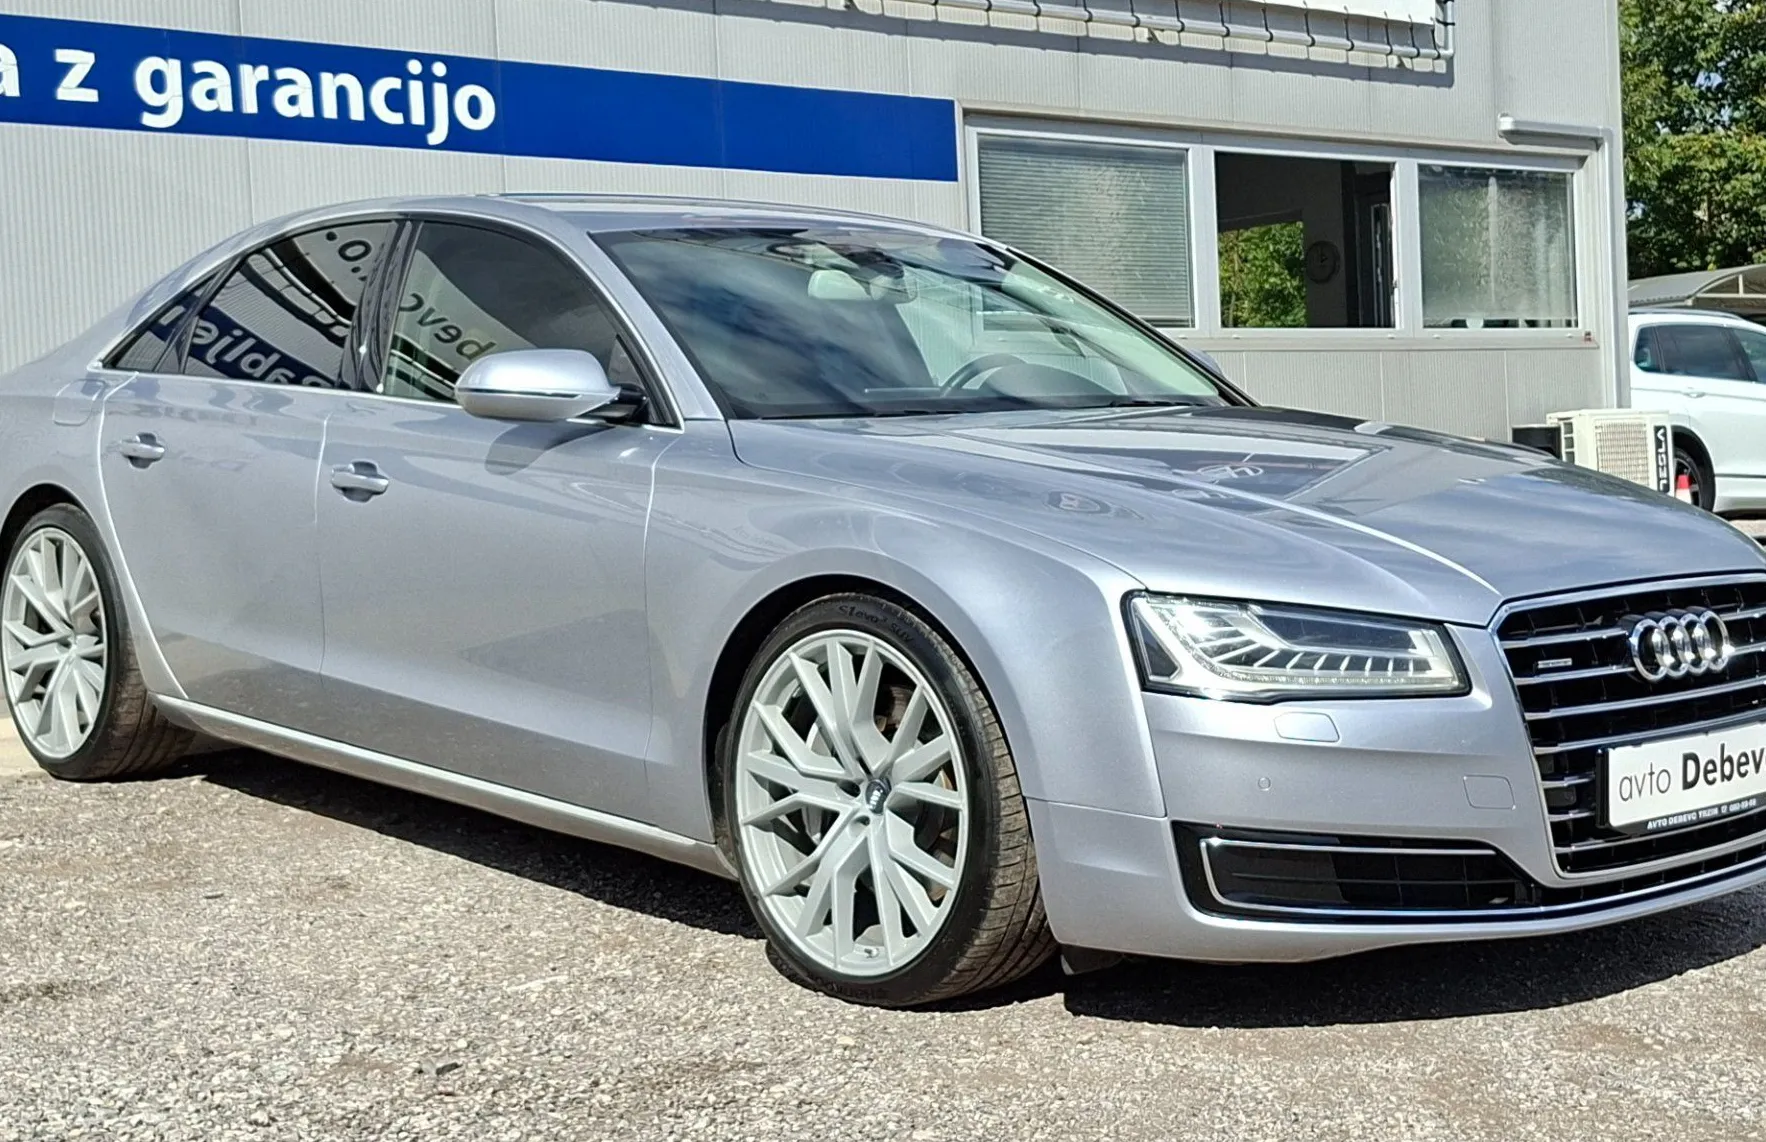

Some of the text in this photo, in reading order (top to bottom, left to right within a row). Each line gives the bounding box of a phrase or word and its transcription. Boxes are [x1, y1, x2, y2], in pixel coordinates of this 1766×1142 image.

[54, 48, 99, 103] z
[134, 54, 497, 146] garancijo
[1619, 742, 1766, 802] avto Debev
[1646, 818, 1668, 831] AVTO
